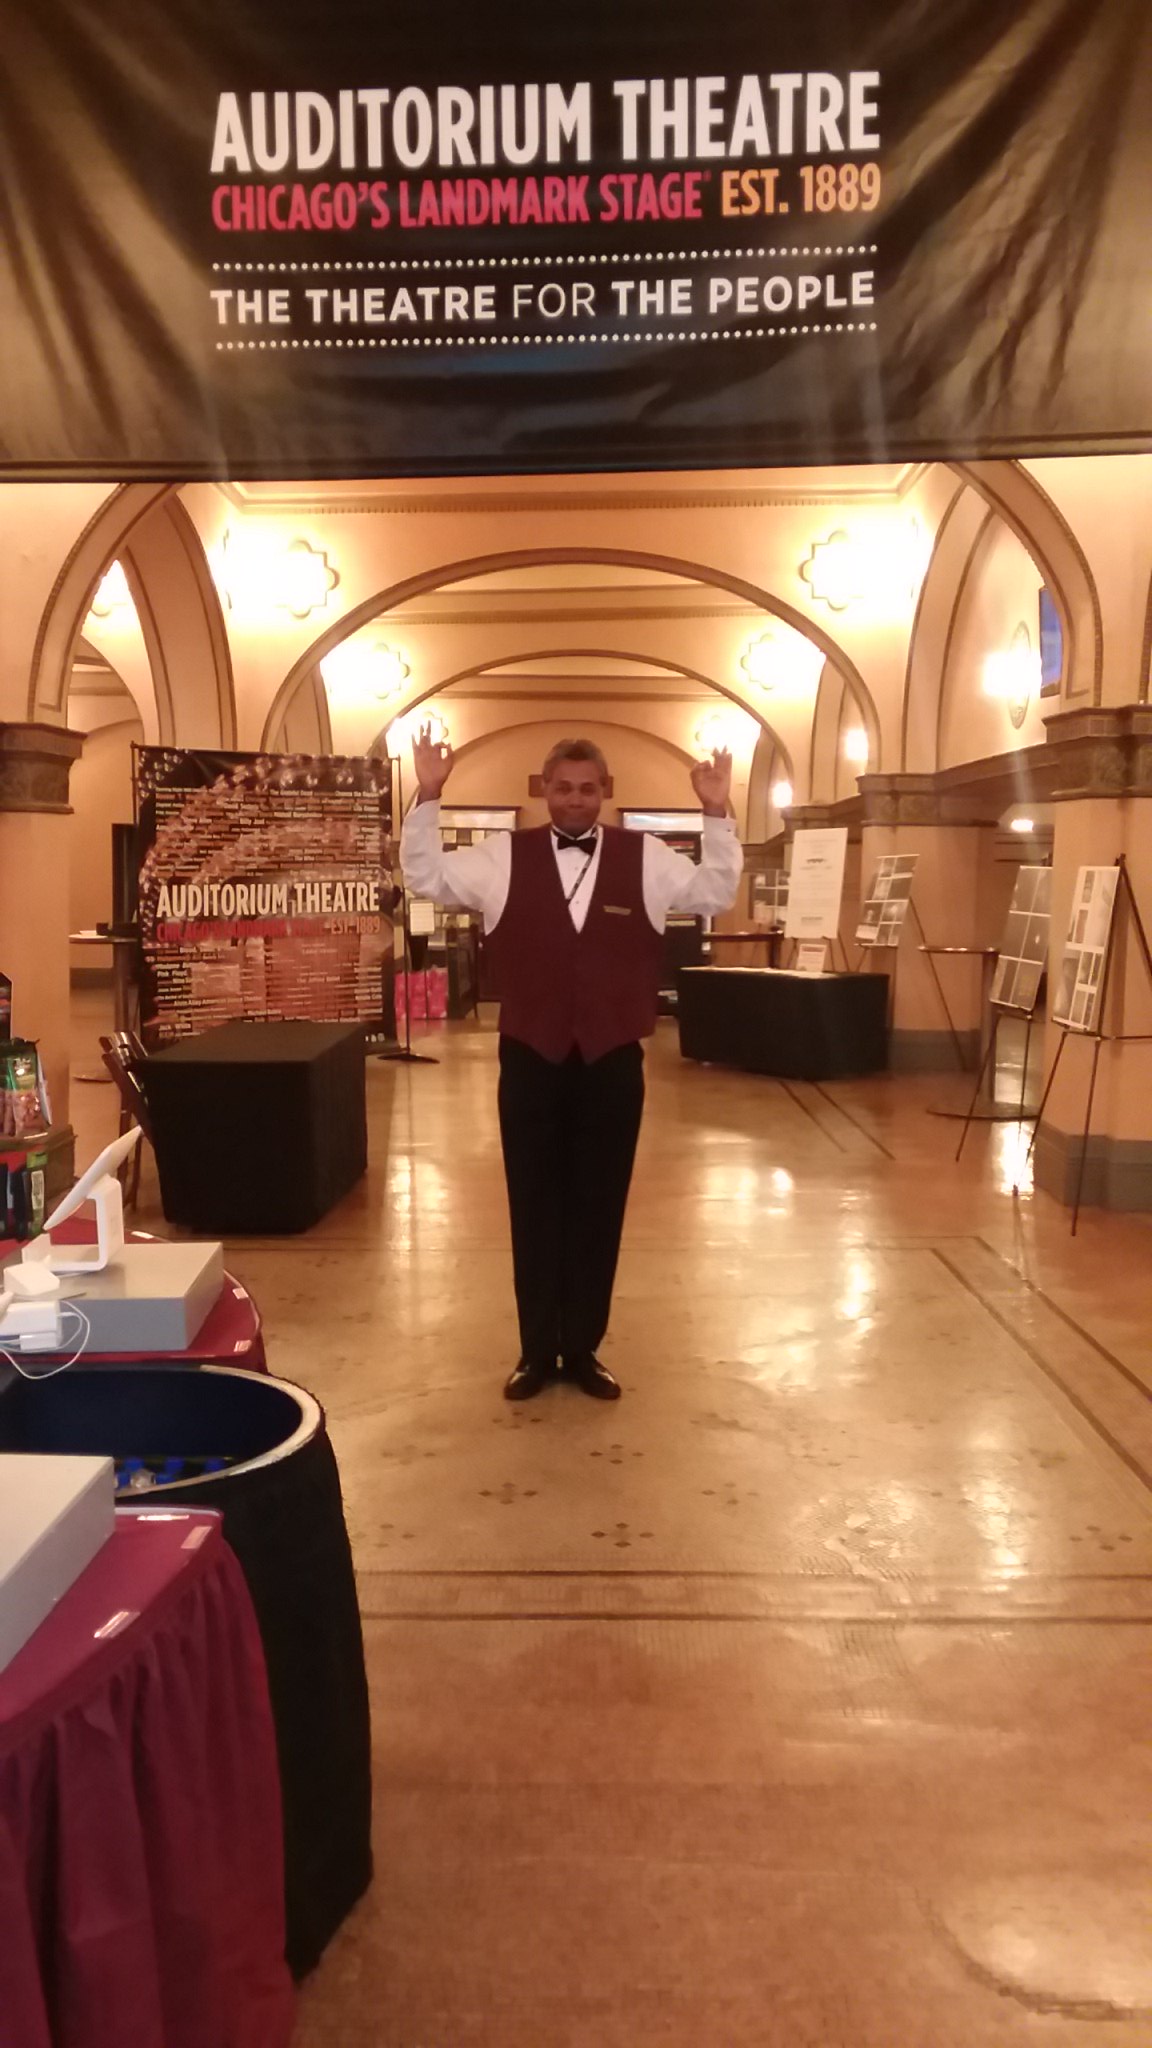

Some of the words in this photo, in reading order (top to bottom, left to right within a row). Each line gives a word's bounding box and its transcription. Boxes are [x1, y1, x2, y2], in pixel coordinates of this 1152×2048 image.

[210, 82, 592, 174] AUDITORIUM
[613, 71, 880, 161] THEATRE
[211, 181, 391, 232] CHICAGO'S
[400, 175, 590, 228] LANDMARK
[721, 168, 789, 217] EST.
[799, 162, 882, 213] 1889
[209, 289, 291, 326] THE
[304, 285, 496, 323] THEATRE
[513, 282, 596, 319] FOR
[611, 279, 693, 316] THE
[709, 270, 876, 314] PEOPLE
[156, 883, 288, 918] AUDITORIUM
[293, 881, 380, 914] THEATRE
[356, 916, 381, 935] 1889
